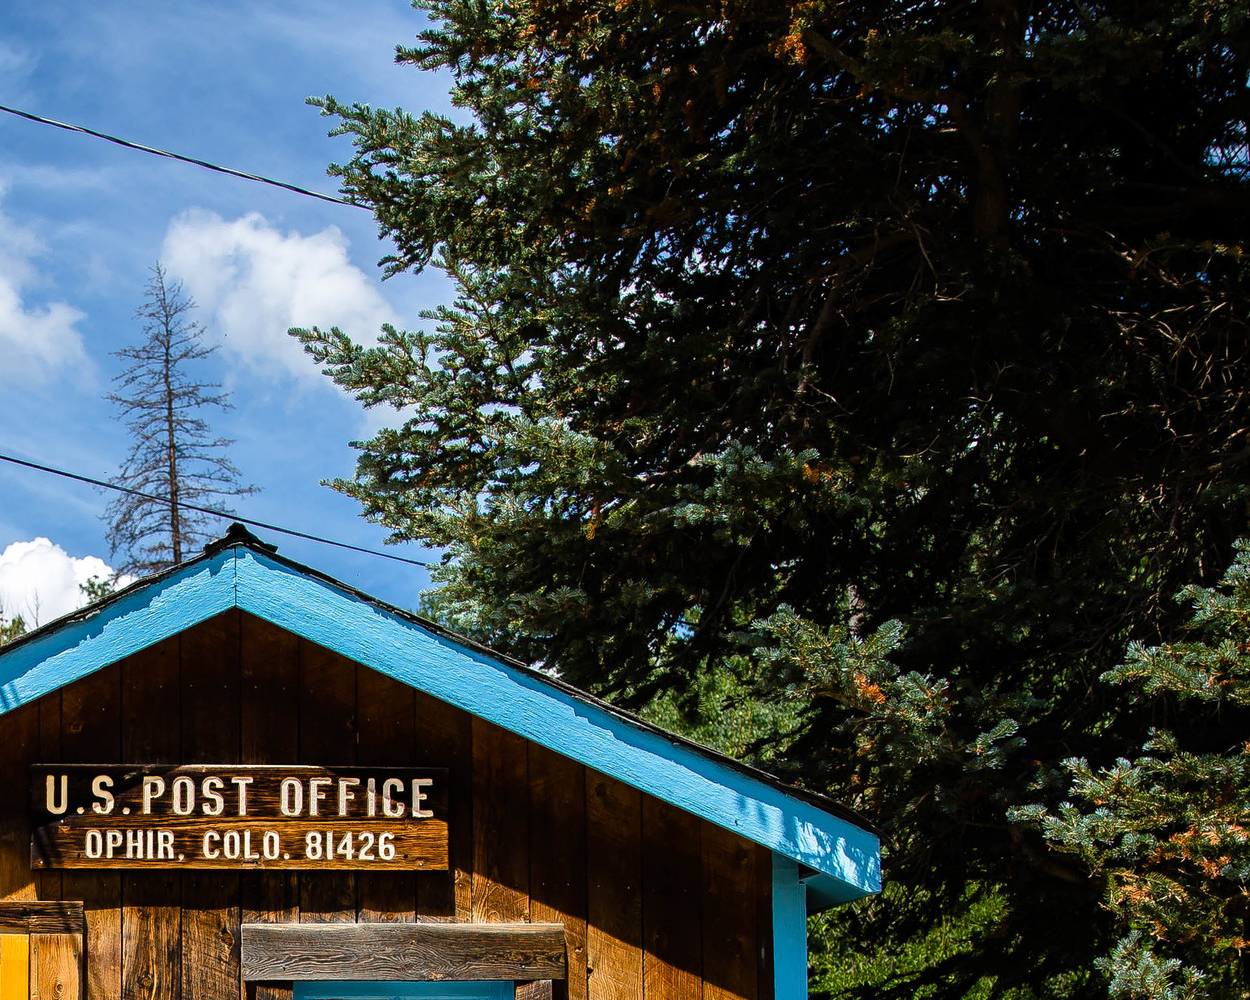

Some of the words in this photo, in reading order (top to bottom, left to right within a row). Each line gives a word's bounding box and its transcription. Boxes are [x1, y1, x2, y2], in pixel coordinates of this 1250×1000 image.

[280, 777, 434, 818] OFFICE
[202, 830, 290, 860] COLO.
[304, 831, 396, 861] 81426
